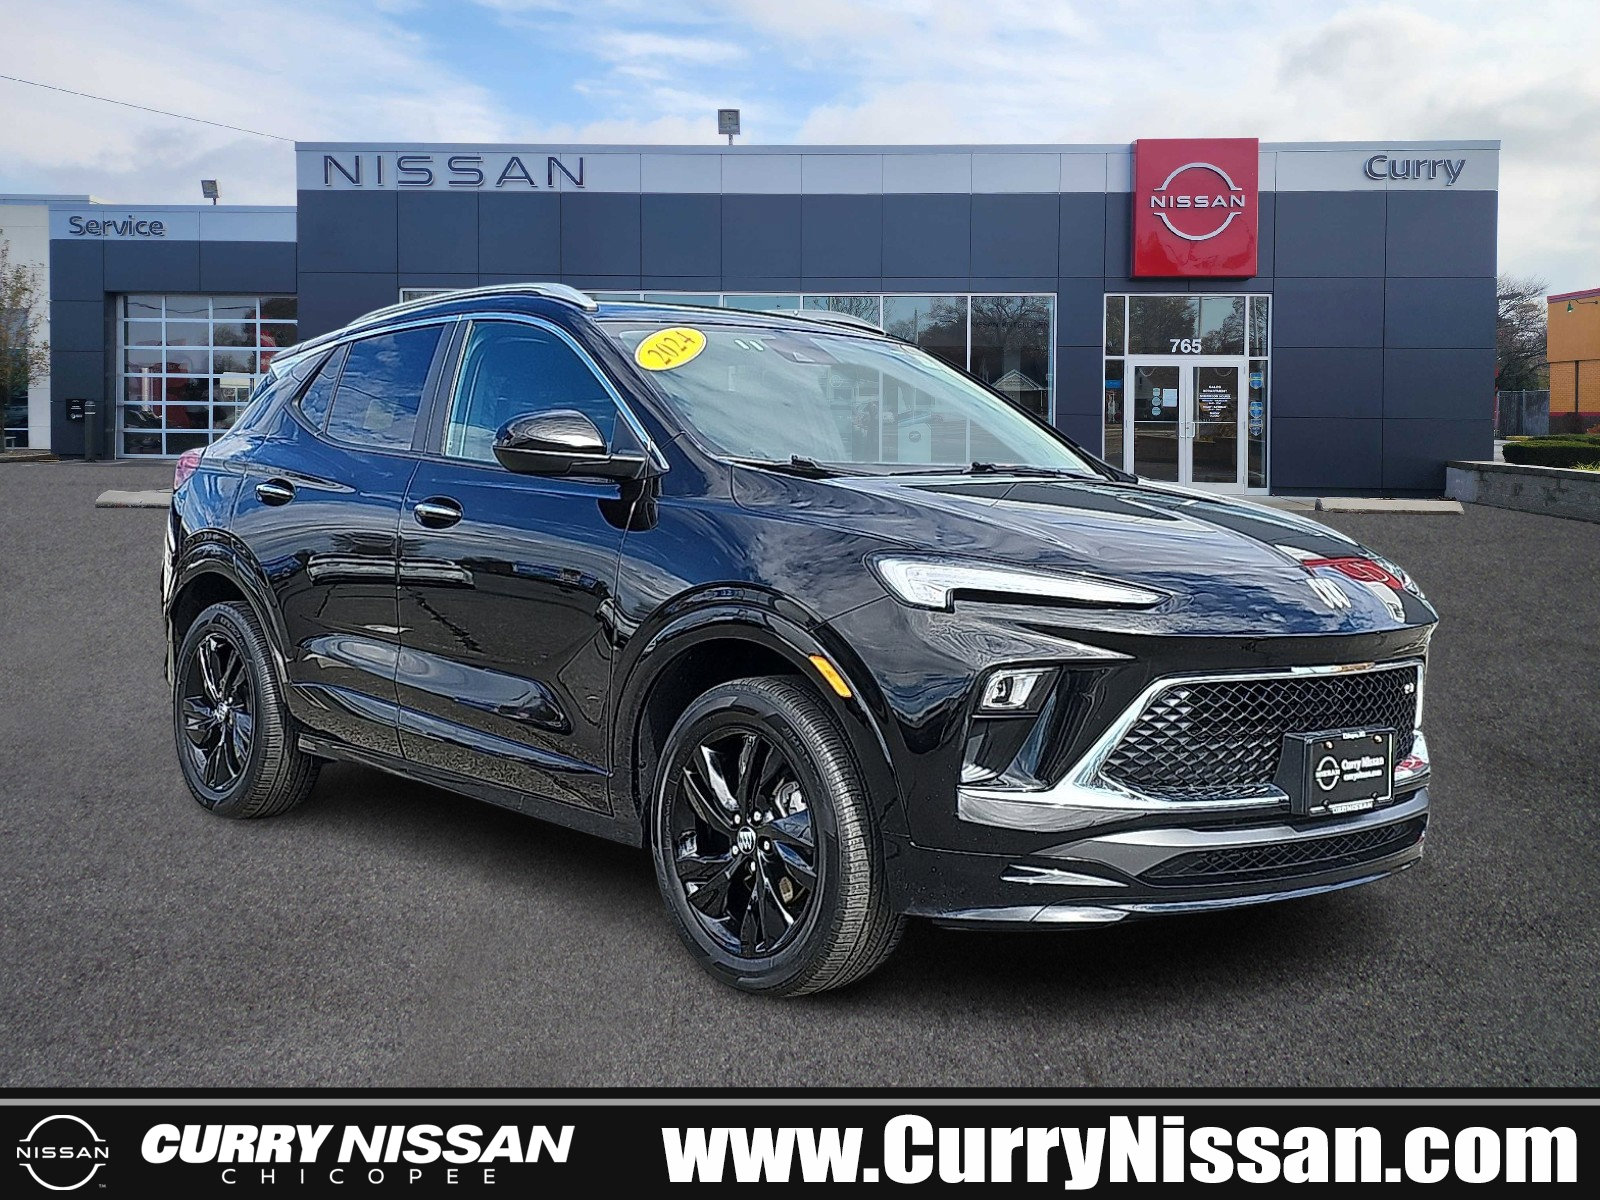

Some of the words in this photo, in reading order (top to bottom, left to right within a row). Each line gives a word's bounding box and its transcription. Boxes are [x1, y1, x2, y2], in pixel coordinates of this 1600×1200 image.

[324, 155, 585, 188] NISSAN
[1365, 154, 1466, 186] Curry
[1150, 194, 1246, 209] NISSAN
[69, 214, 167, 237] Service
[648, 330, 696, 366] 2024
[1169, 338, 1202, 354] 765
